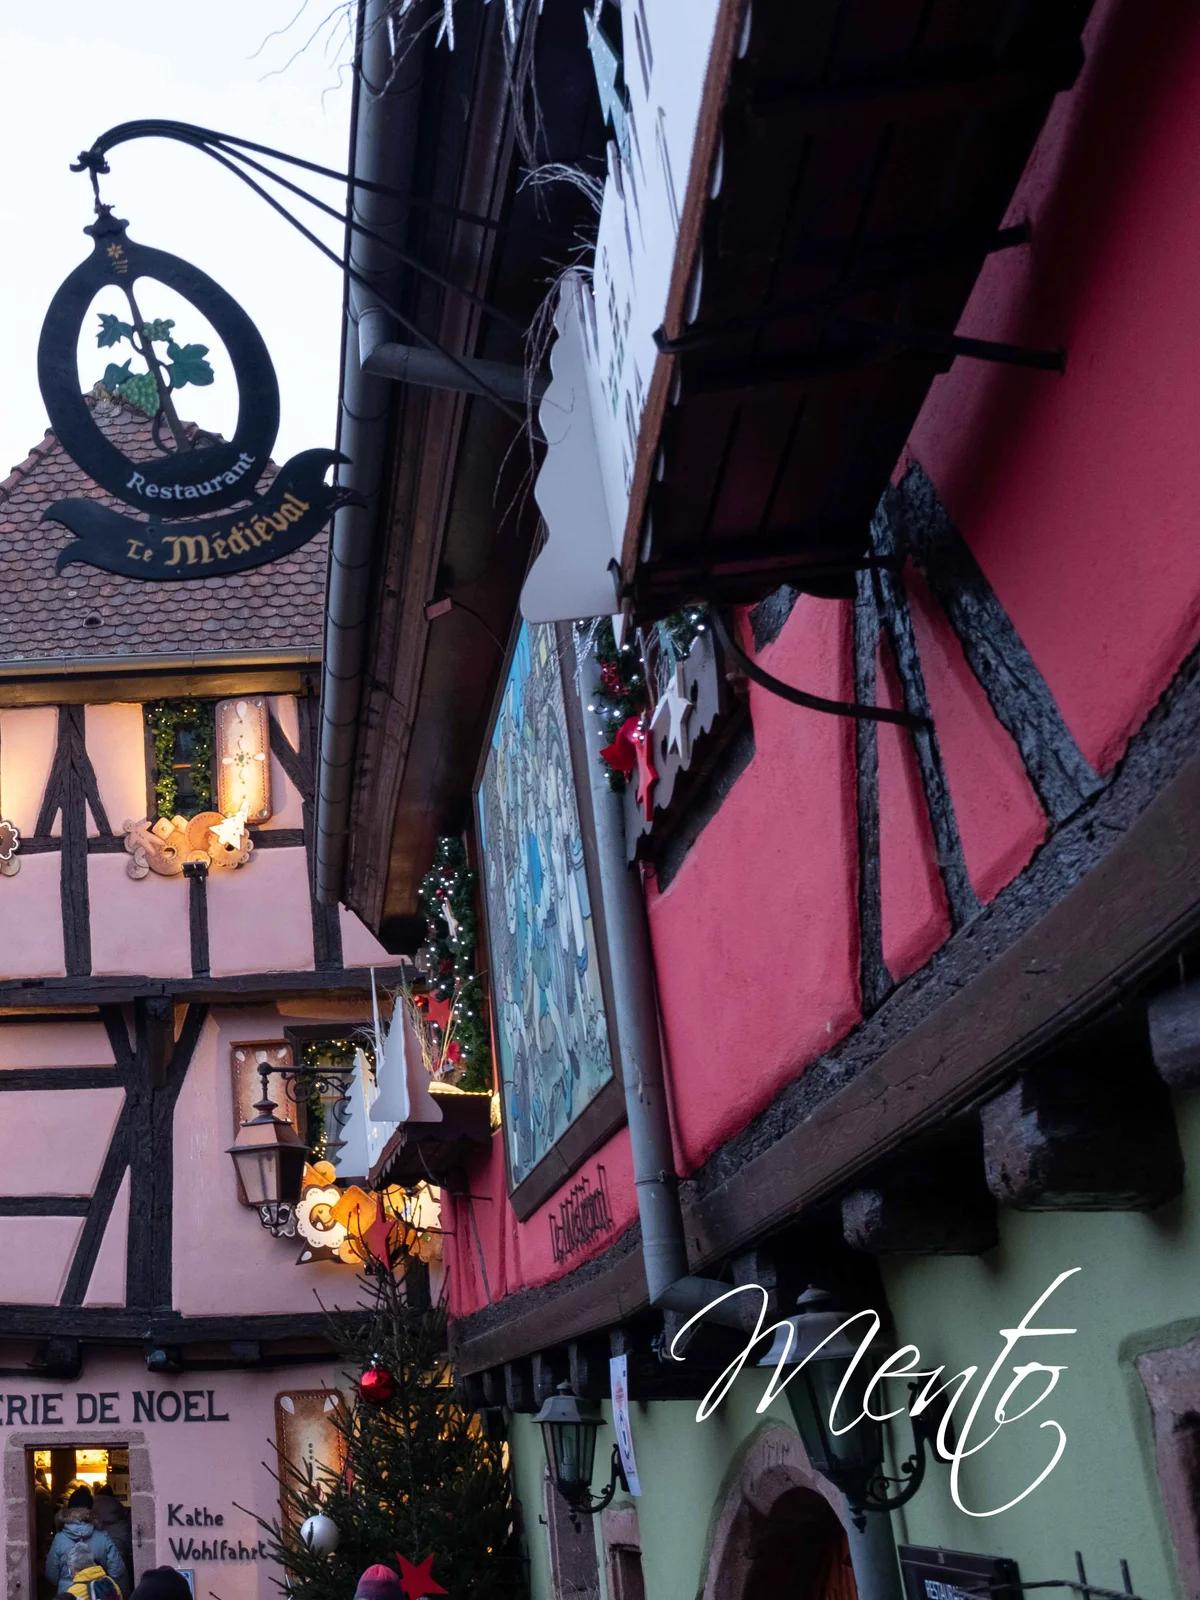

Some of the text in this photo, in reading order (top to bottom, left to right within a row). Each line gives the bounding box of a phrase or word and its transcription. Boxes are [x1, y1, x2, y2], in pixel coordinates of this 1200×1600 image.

[126, 452, 256, 500] Restaurant
[126, 492, 310, 566] Le Médiéval
[76, 1391, 120, 1425] DE
[132, 1390, 229, 1423] NOEL
[167, 1503, 224, 1527] Kathe
[168, 1537, 269, 1562] Wohlfahrt
